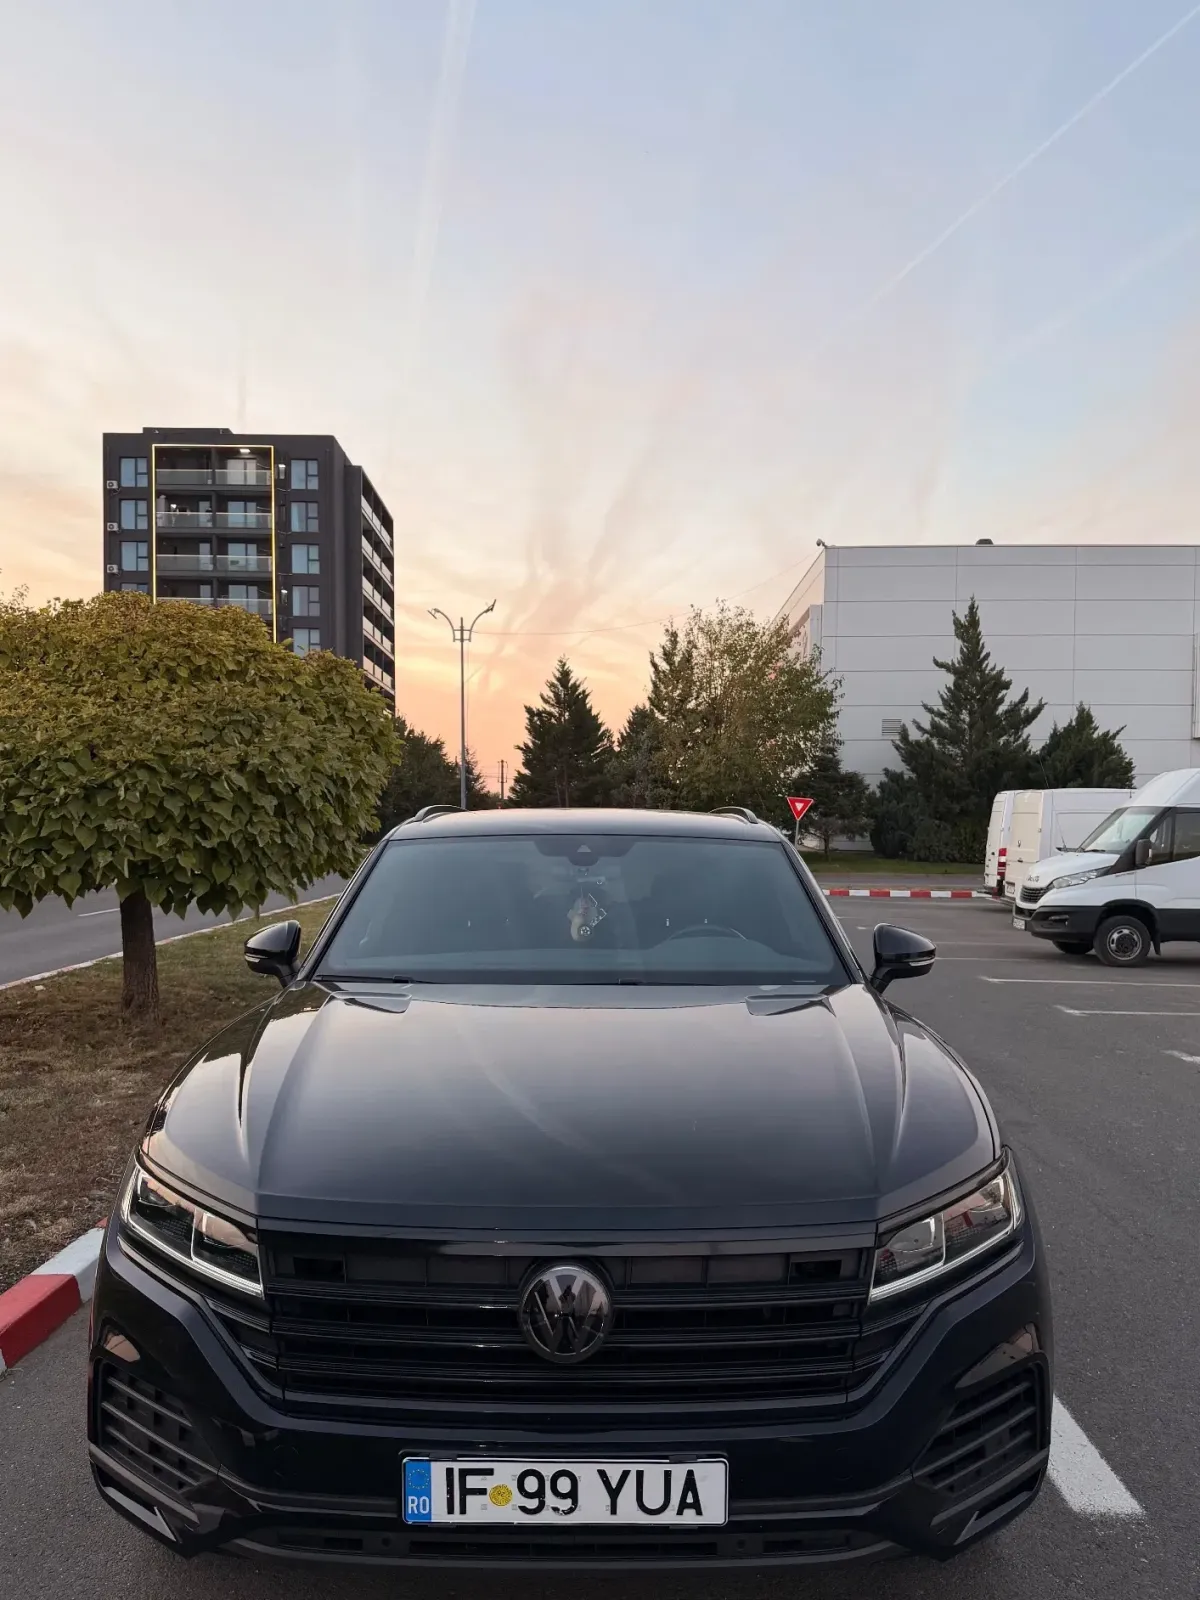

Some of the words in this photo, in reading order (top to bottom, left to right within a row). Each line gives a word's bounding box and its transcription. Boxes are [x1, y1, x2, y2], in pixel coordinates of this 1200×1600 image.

[408, 1495, 430, 1514] RO
[446, 1467, 494, 1515] IF
[517, 1468, 578, 1516] 99
[596, 1469, 703, 1516] YUA
